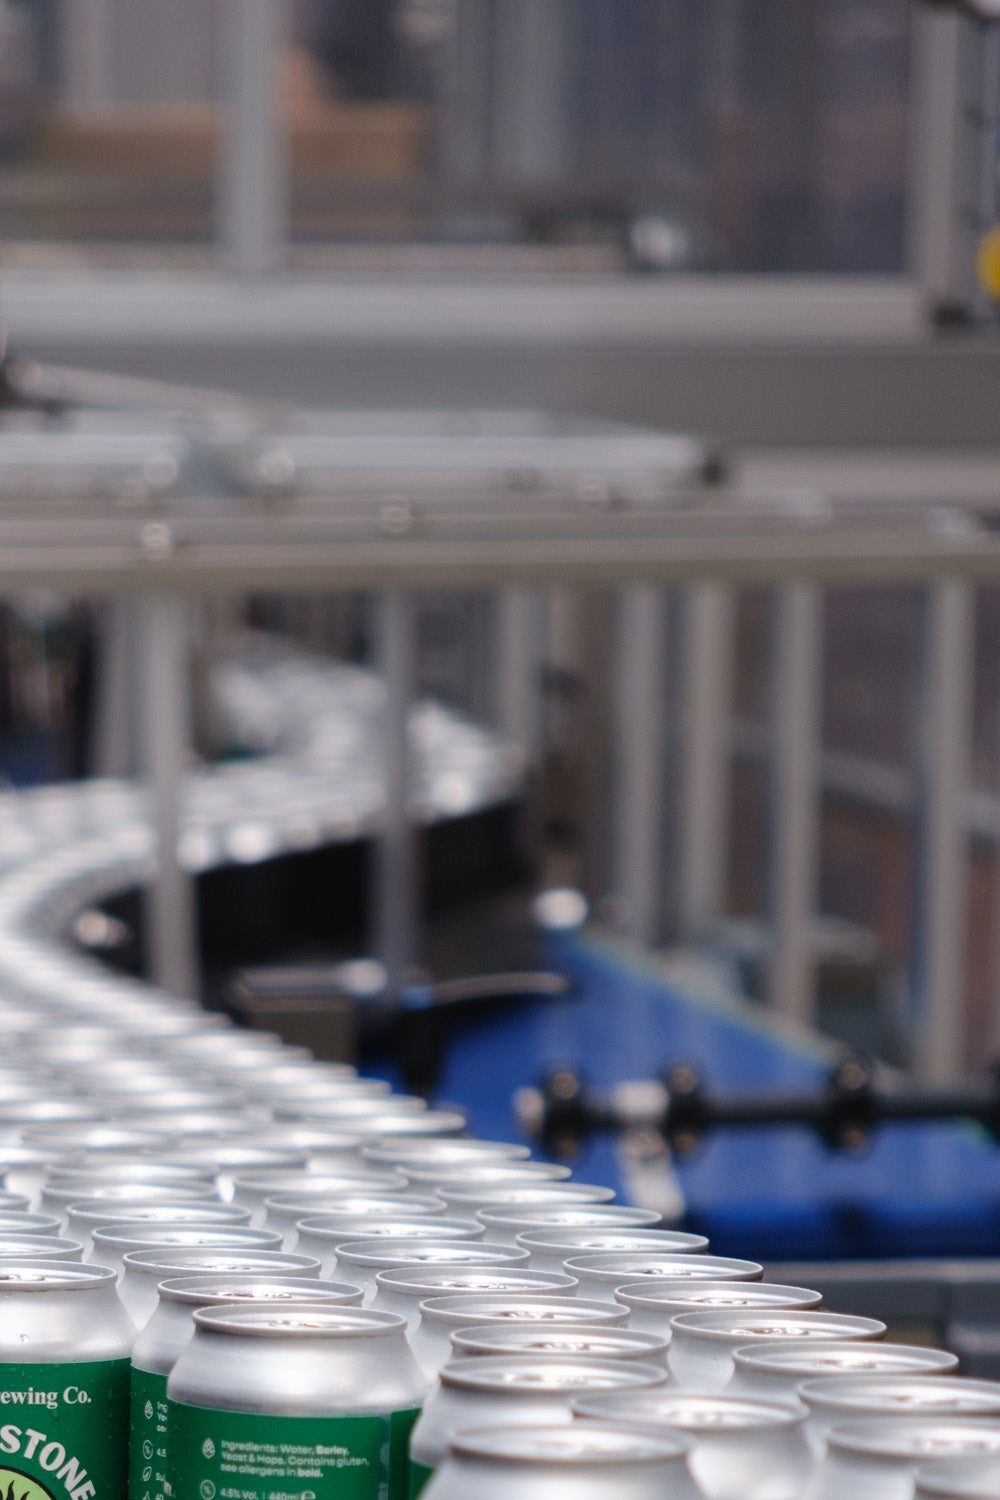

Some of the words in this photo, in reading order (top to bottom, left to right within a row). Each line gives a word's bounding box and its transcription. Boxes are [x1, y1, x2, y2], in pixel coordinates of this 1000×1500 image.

[63, 1386, 92, 1404] Co.
[221, 1440, 278, 1453] Ingredients:
[280, 1445, 315, 1455] Water,
[316, 1445, 350, 1456] Barley,
[221, 1452, 247, 1462] Yeast
[250, 1454, 255, 1463] &
[288, 1456, 335, 1467] Contains
[337, 1457, 369, 1468] gluten,
[220, 1464, 237, 1473] see
[239, 1464, 285, 1477] allergens
[287, 1468, 297, 1476] in
[298, 1468, 324, 1477] bold.
[220, 1488, 241, 1499] 4.5%
[242, 1490, 259, 1500] Vol.
